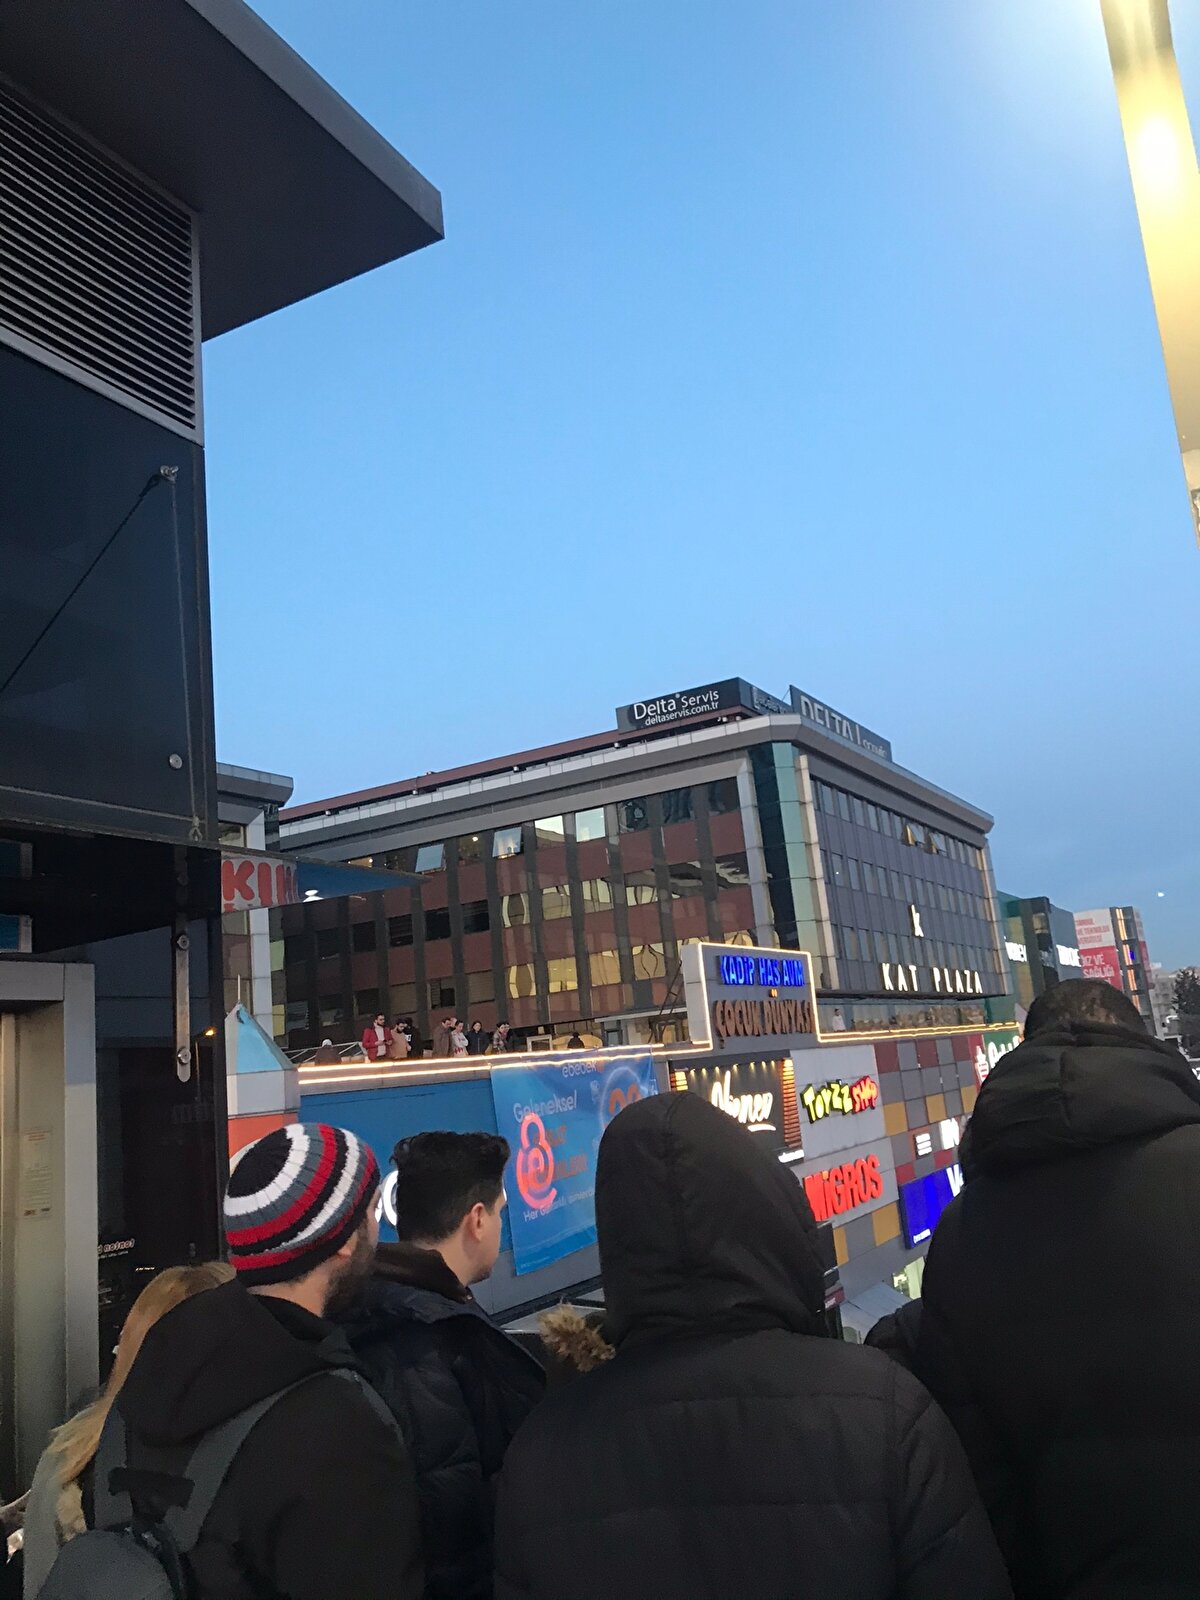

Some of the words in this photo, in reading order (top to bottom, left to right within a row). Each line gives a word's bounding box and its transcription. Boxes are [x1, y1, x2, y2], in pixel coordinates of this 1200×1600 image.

[633, 696, 676, 721] Delta
[681, 689, 719, 709] Servis
[644, 701, 719, 727] deltaservis.com.tr
[801, 694, 853, 742] DELTA
[759, 957, 781, 987] HAS
[882, 962, 918, 992] KAT
[932, 966, 983, 994] PLAZA
[715, 999, 762, 1048] ÇOCUK
